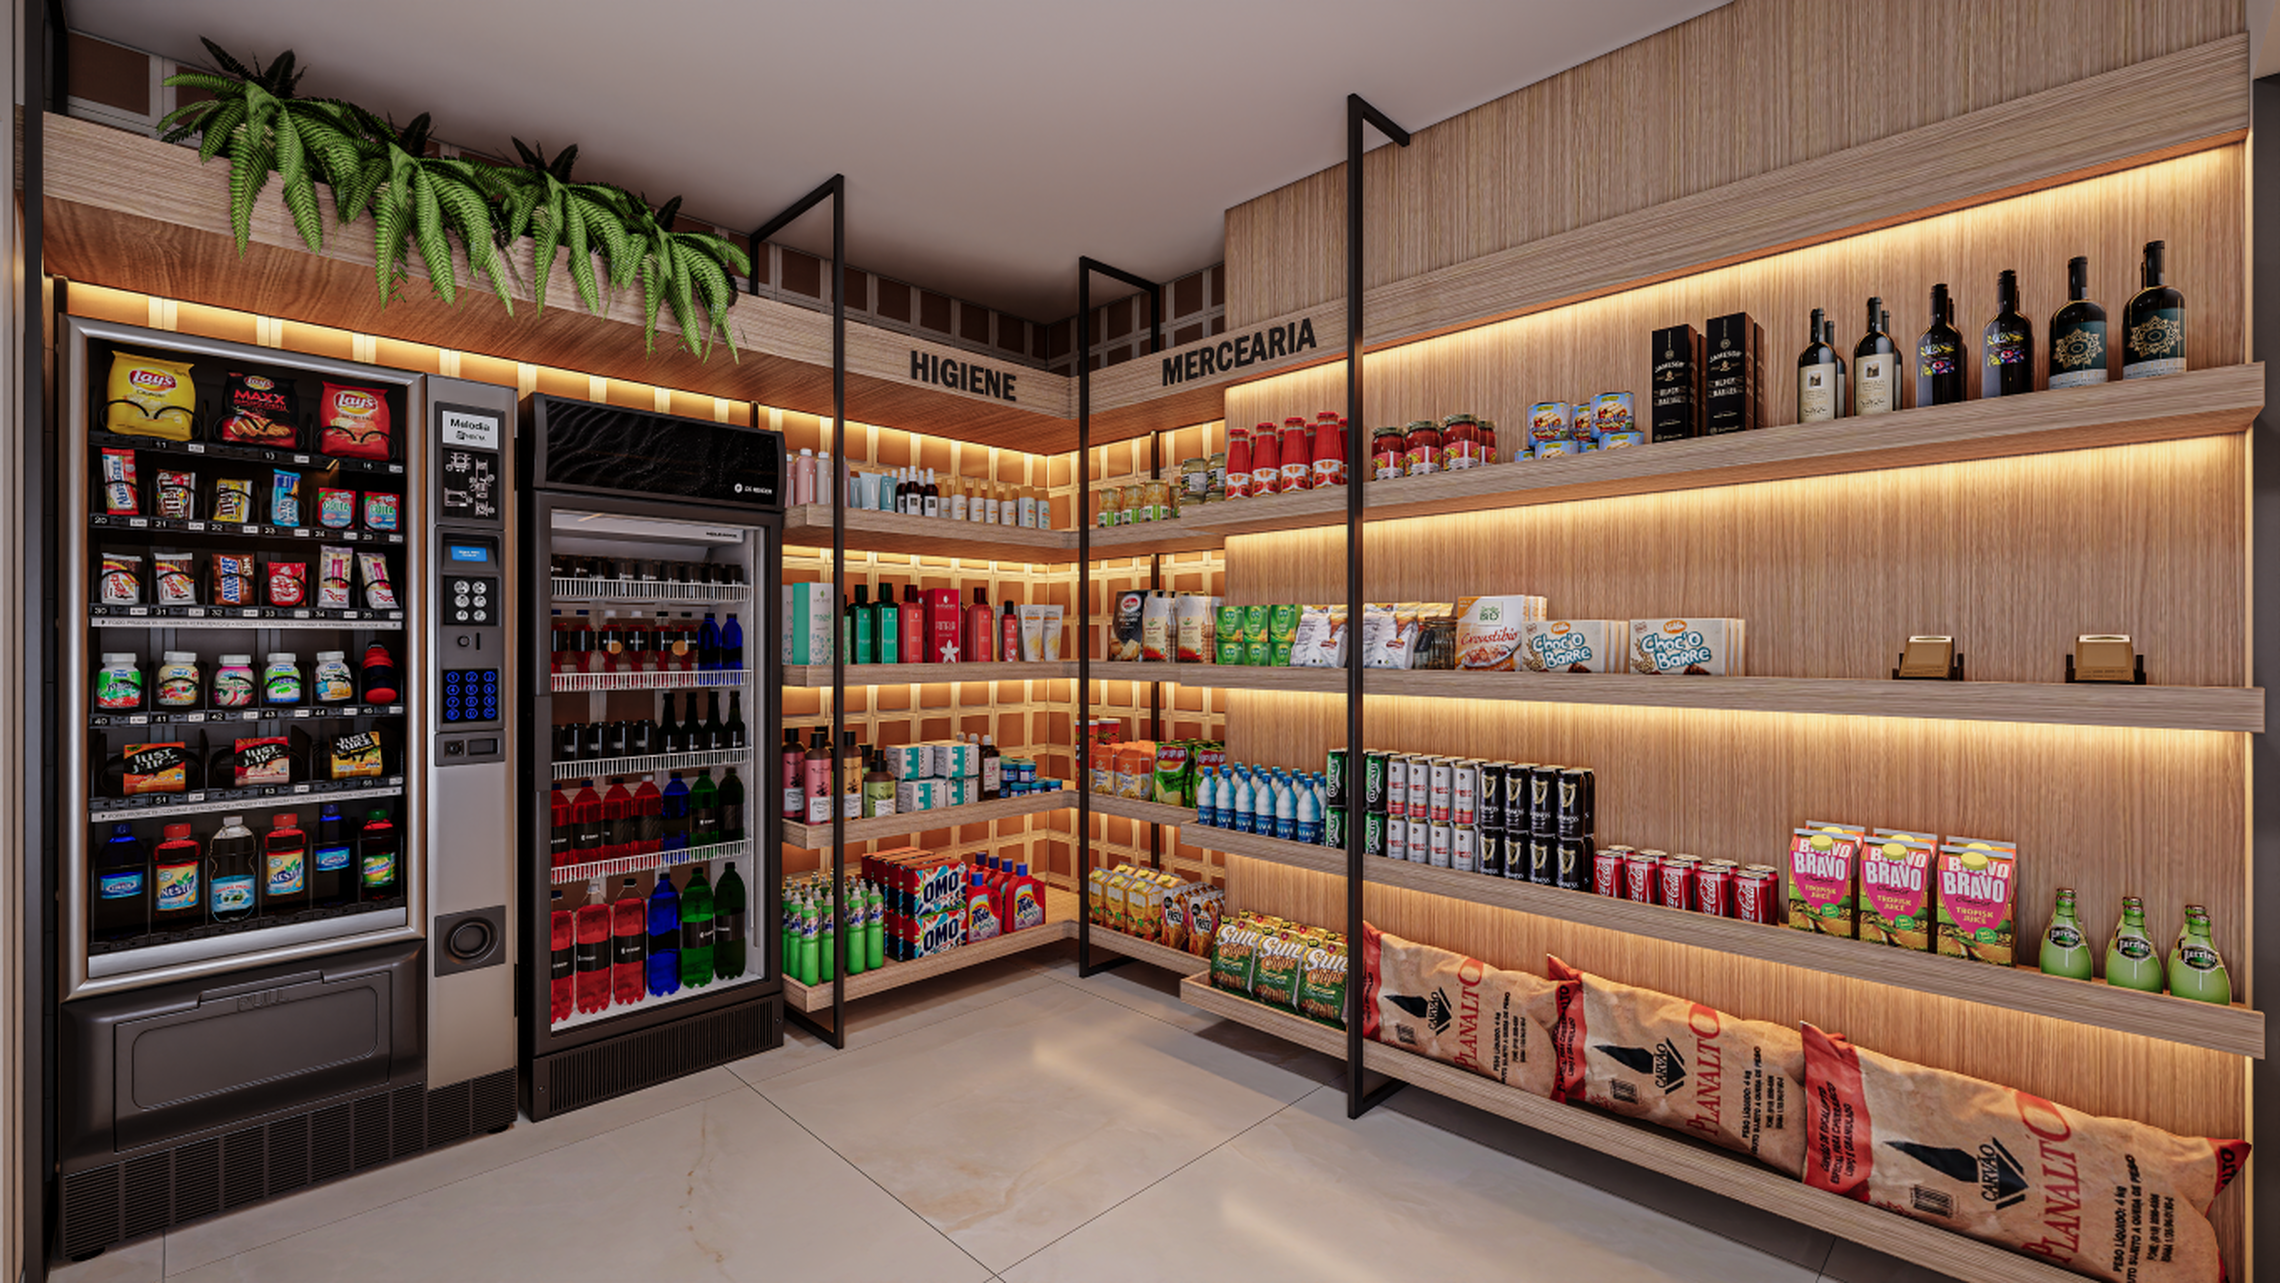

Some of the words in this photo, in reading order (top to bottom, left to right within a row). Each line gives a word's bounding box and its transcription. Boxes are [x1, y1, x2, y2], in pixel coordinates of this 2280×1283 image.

[1161, 318, 1317, 386] MERCEARIA
[910, 350, 1018, 402] HIGIENE
[233, 389, 285, 405] MAXX
[1799, 837, 1852, 859] BVO
[1870, 846, 1927, 869] BVO
[1793, 851, 1846, 881] BRAVO
[1865, 861, 1922, 891] BRAVO
[1948, 856, 2009, 879] BVO
[923, 871, 958, 903] OMO
[1942, 871, 2005, 903] BRAVO
[1955, 906, 1995, 919] TROPISK
[923, 917, 958, 951] OMO
[1218, 924, 1259, 946] Sun
[1259, 936, 1300, 958] Sun
[1219, 943, 1252, 960] Chips
[1261, 955, 1296, 973] Chips
[1305, 949, 1347, 973] Sun
[1306, 969, 1344, 987] Chips
[1428, 991, 1439, 1031] CARVÃO
[1454, 957, 1484, 1072] PLANALTO
[1655, 1043, 1667, 1089] CARVÃO
[1686, 1002, 1721, 1136] PLANALTO
[1979, 1143, 1999, 1202] CARVÃO
[2016, 1090, 2081, 1265] PLANALTO
[2125, 1154, 2142, 1184] PESO
[2114, 1186, 2127, 1198] kg
[2130, 1186, 2141, 1197] DE
[2130, 1199, 2141, 1226] QUEDA
[2112, 1249, 2124, 1272] PESO
[2128, 1235, 2141, 1266] SUJEITO
